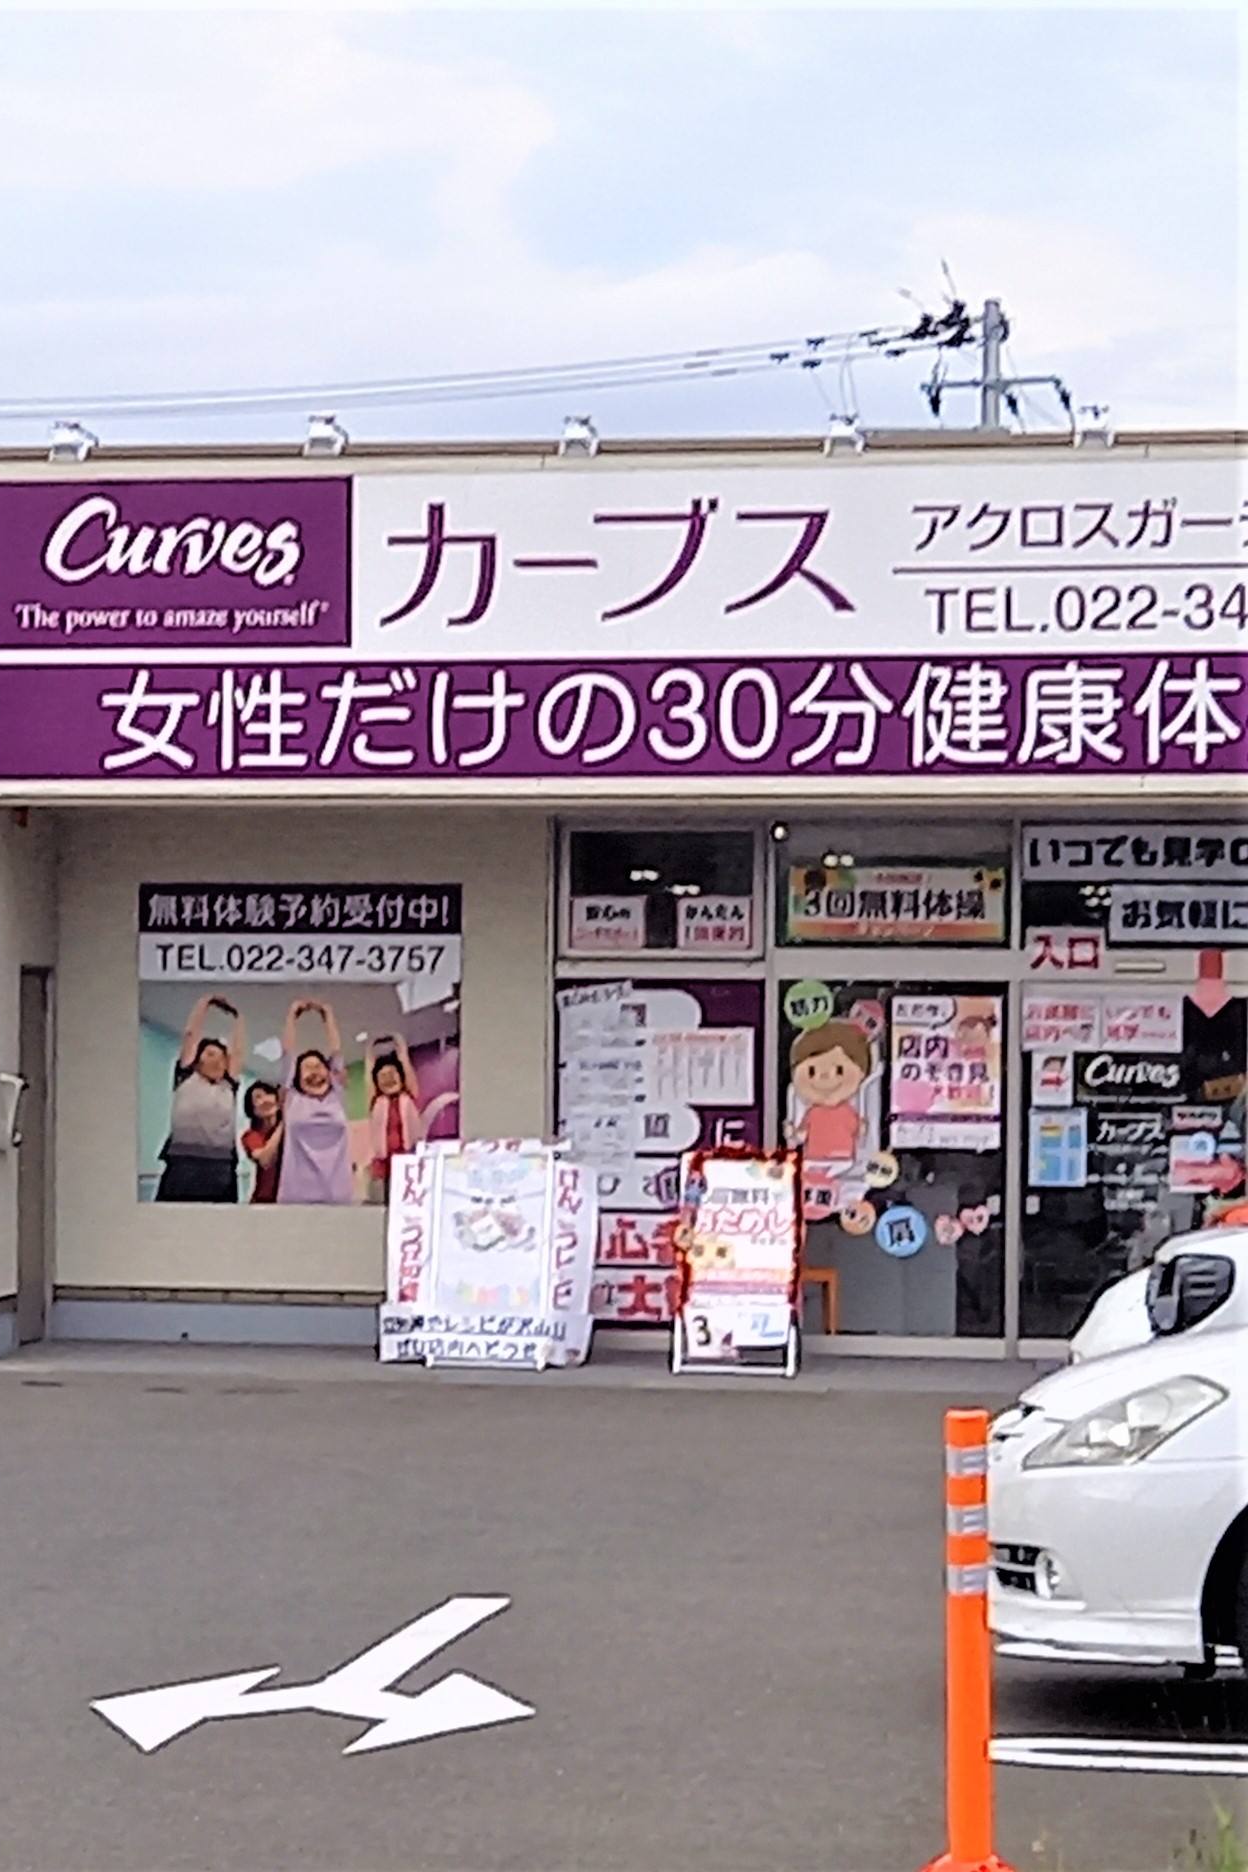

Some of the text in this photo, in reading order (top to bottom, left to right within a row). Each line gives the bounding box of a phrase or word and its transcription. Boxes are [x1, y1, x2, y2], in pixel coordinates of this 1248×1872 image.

[44, 495, 302, 587] Curves
[911, 497, 1248, 552] アクロスガー
[379, 497, 856, 628] カーブス
[65, 607, 130, 634] power
[135, 609, 157, 628] to
[162, 608, 228, 628] amaze
[101, 659, 1244, 772] 女性だけの30分健康体
[156, 944, 446, 974] TEL.022-347-3757
[1030, 935, 1101, 969] 入口
[897, 1033, 949, 1060] 店内
[1084, 1053, 1181, 1088] Curves
